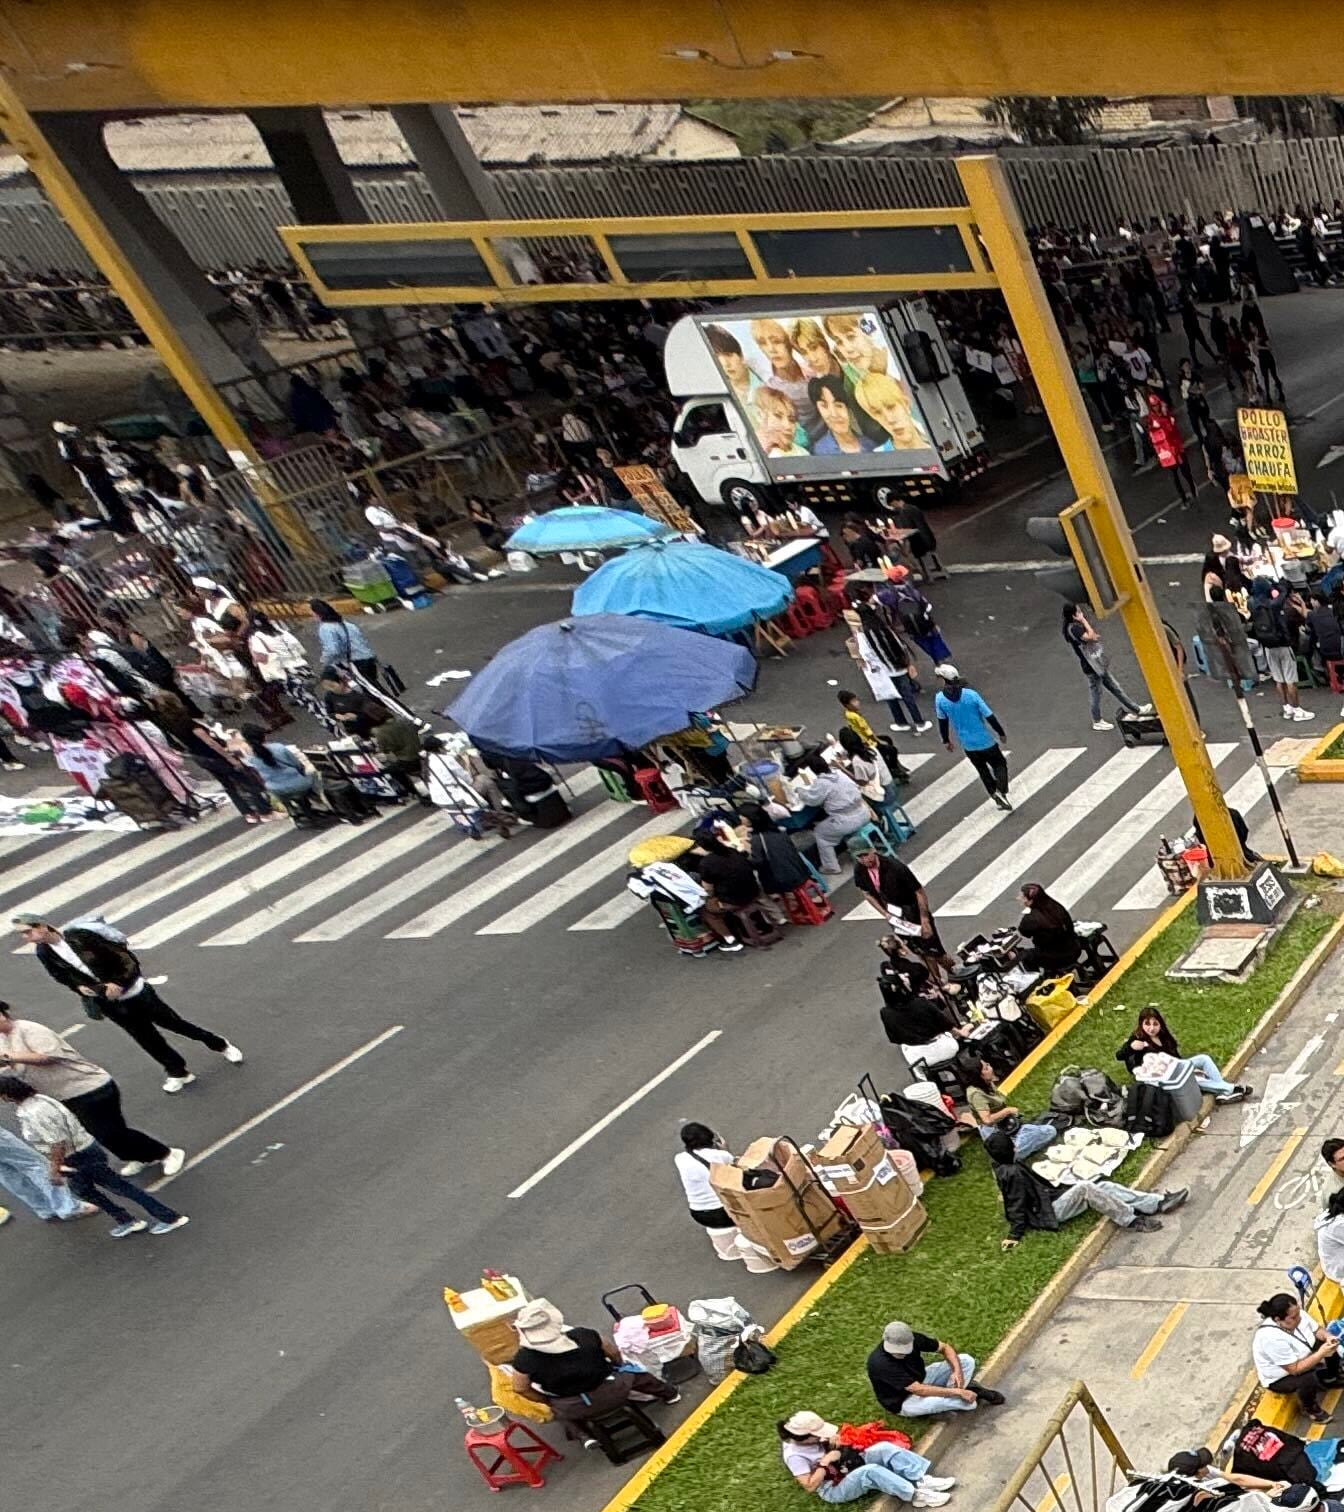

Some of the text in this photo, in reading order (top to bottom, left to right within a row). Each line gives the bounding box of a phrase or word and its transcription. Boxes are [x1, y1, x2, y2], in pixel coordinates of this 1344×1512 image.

[1242, 410, 1281, 427] POLLO
[1249, 444, 1286, 459] ARROZ
[1247, 460, 1291, 477] CHAUFA
